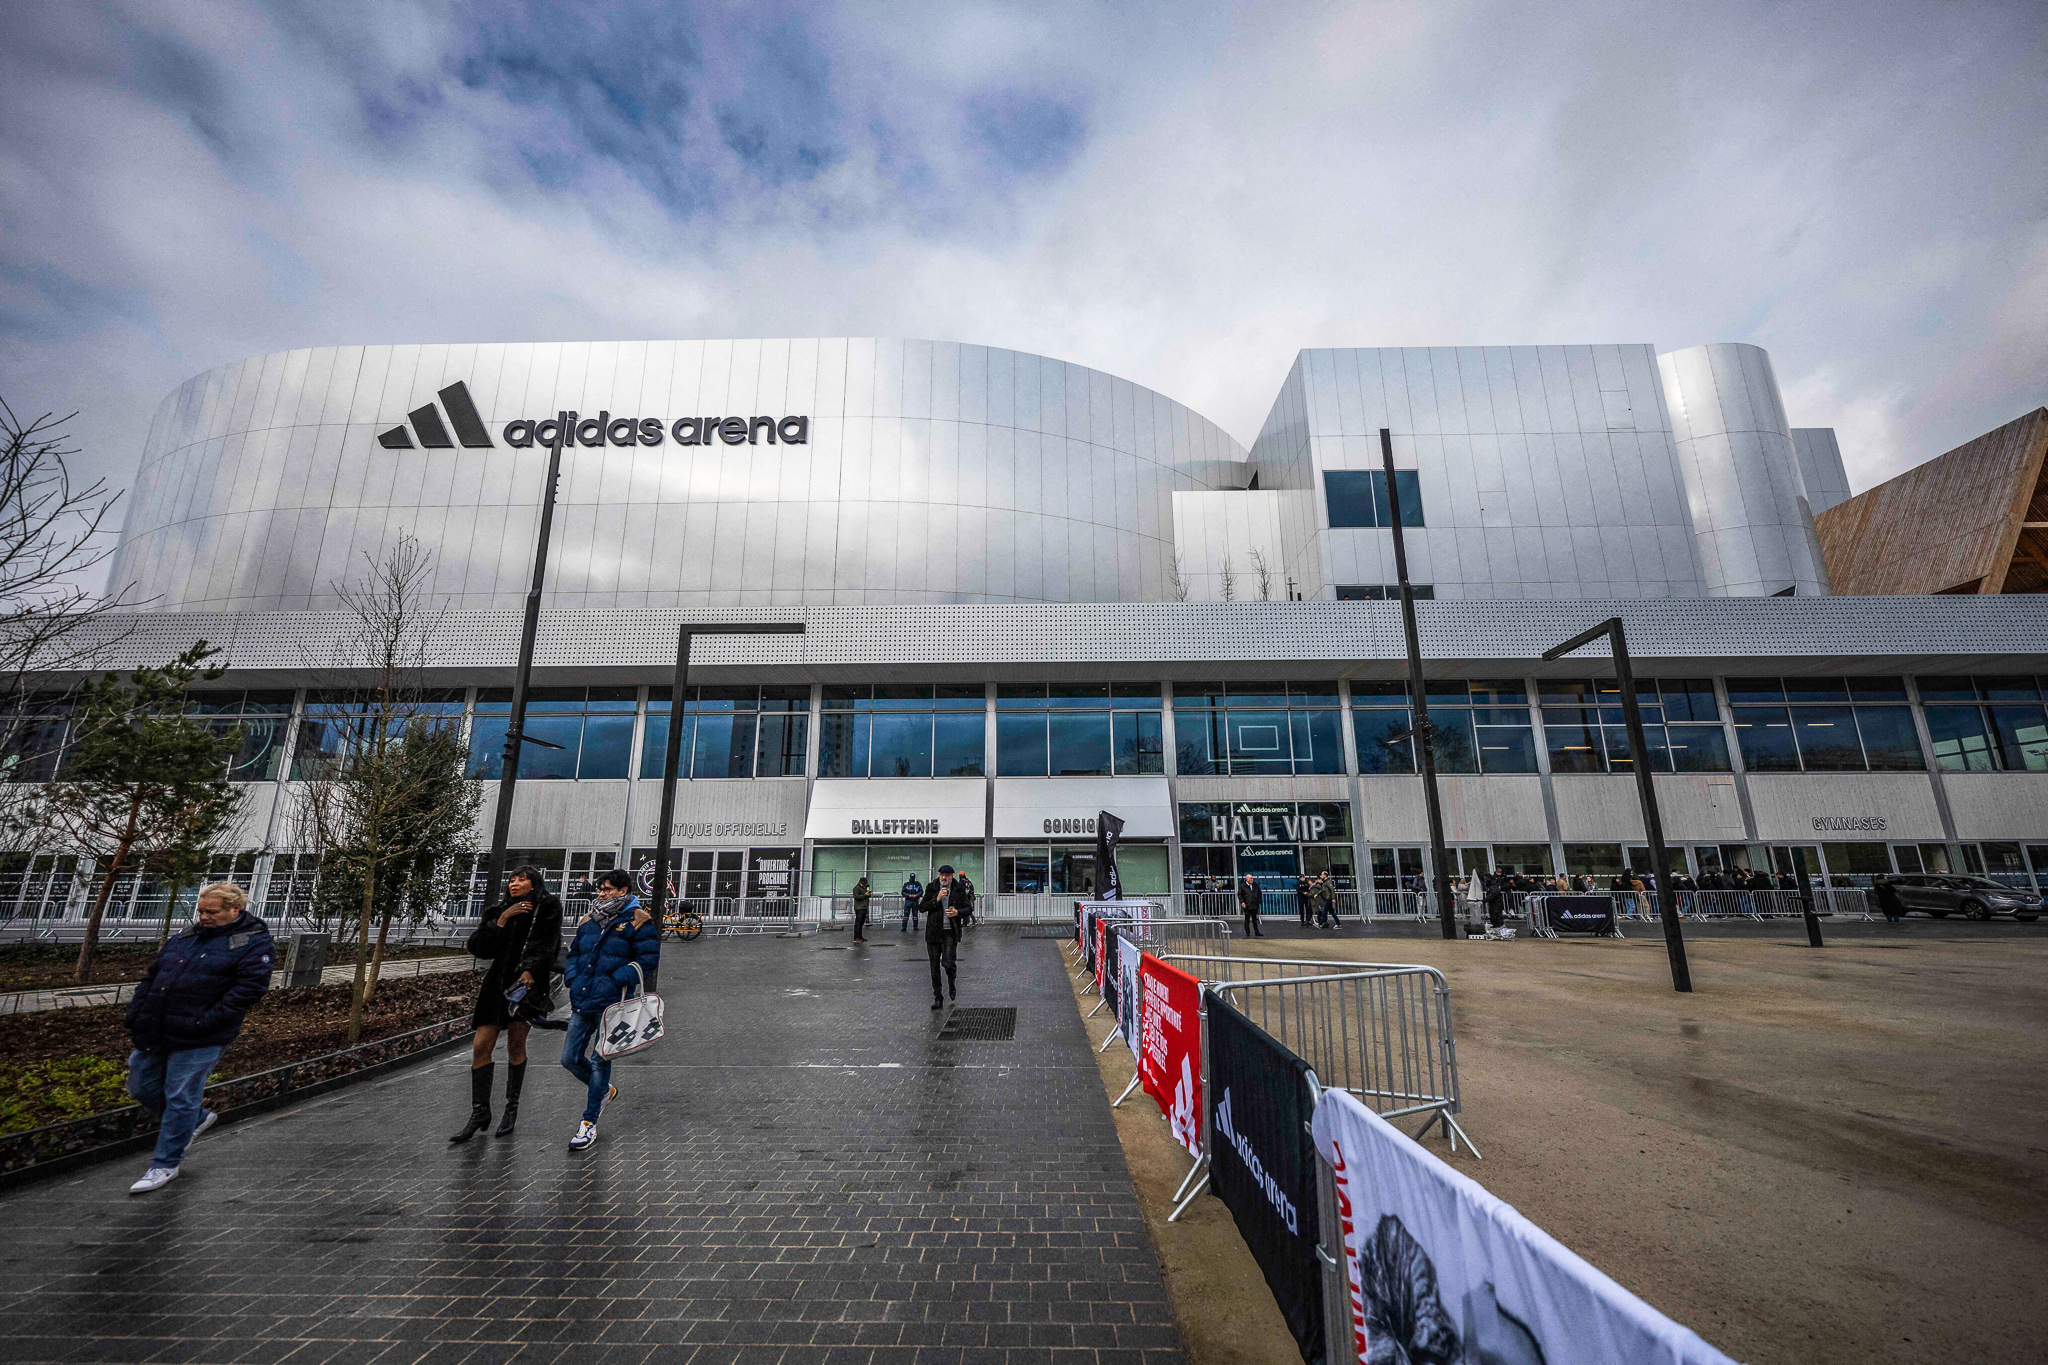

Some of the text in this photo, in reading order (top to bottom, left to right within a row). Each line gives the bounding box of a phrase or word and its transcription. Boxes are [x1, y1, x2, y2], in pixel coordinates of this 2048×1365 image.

[503, 411, 808, 447] adidas arena
[650, 823, 787, 838] BUTIQUE OFFICIELLE
[851, 819, 938, 834] BILLETTERIE
[1044, 819, 1100, 833] CONSIG
[1211, 815, 1326, 841] HALL VIP
[1812, 817, 1887, 830] GYMNASES
[760, 859, 789, 871] OUVERTURE
[1265, 1171, 1298, 1237] arena
